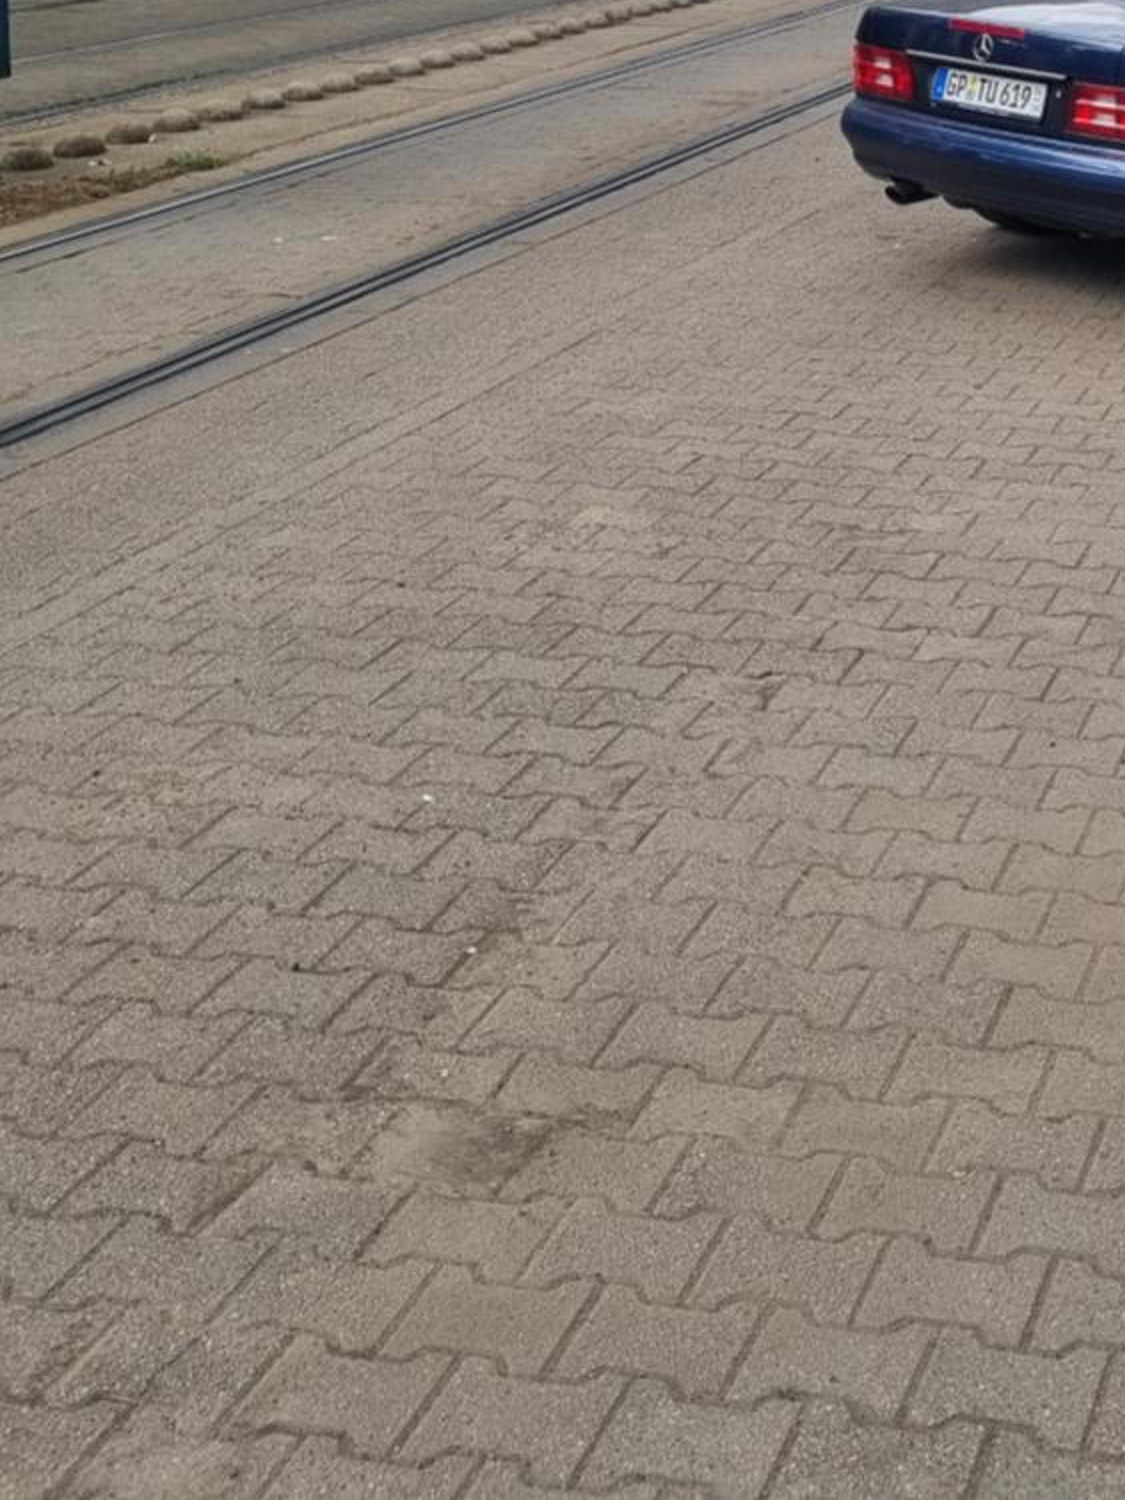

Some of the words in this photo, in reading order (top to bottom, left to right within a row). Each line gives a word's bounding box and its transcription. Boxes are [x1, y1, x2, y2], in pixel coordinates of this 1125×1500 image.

[946, 71, 967, 96] GP
[977, 77, 999, 103] TU
[999, 82, 1032, 109] 619
